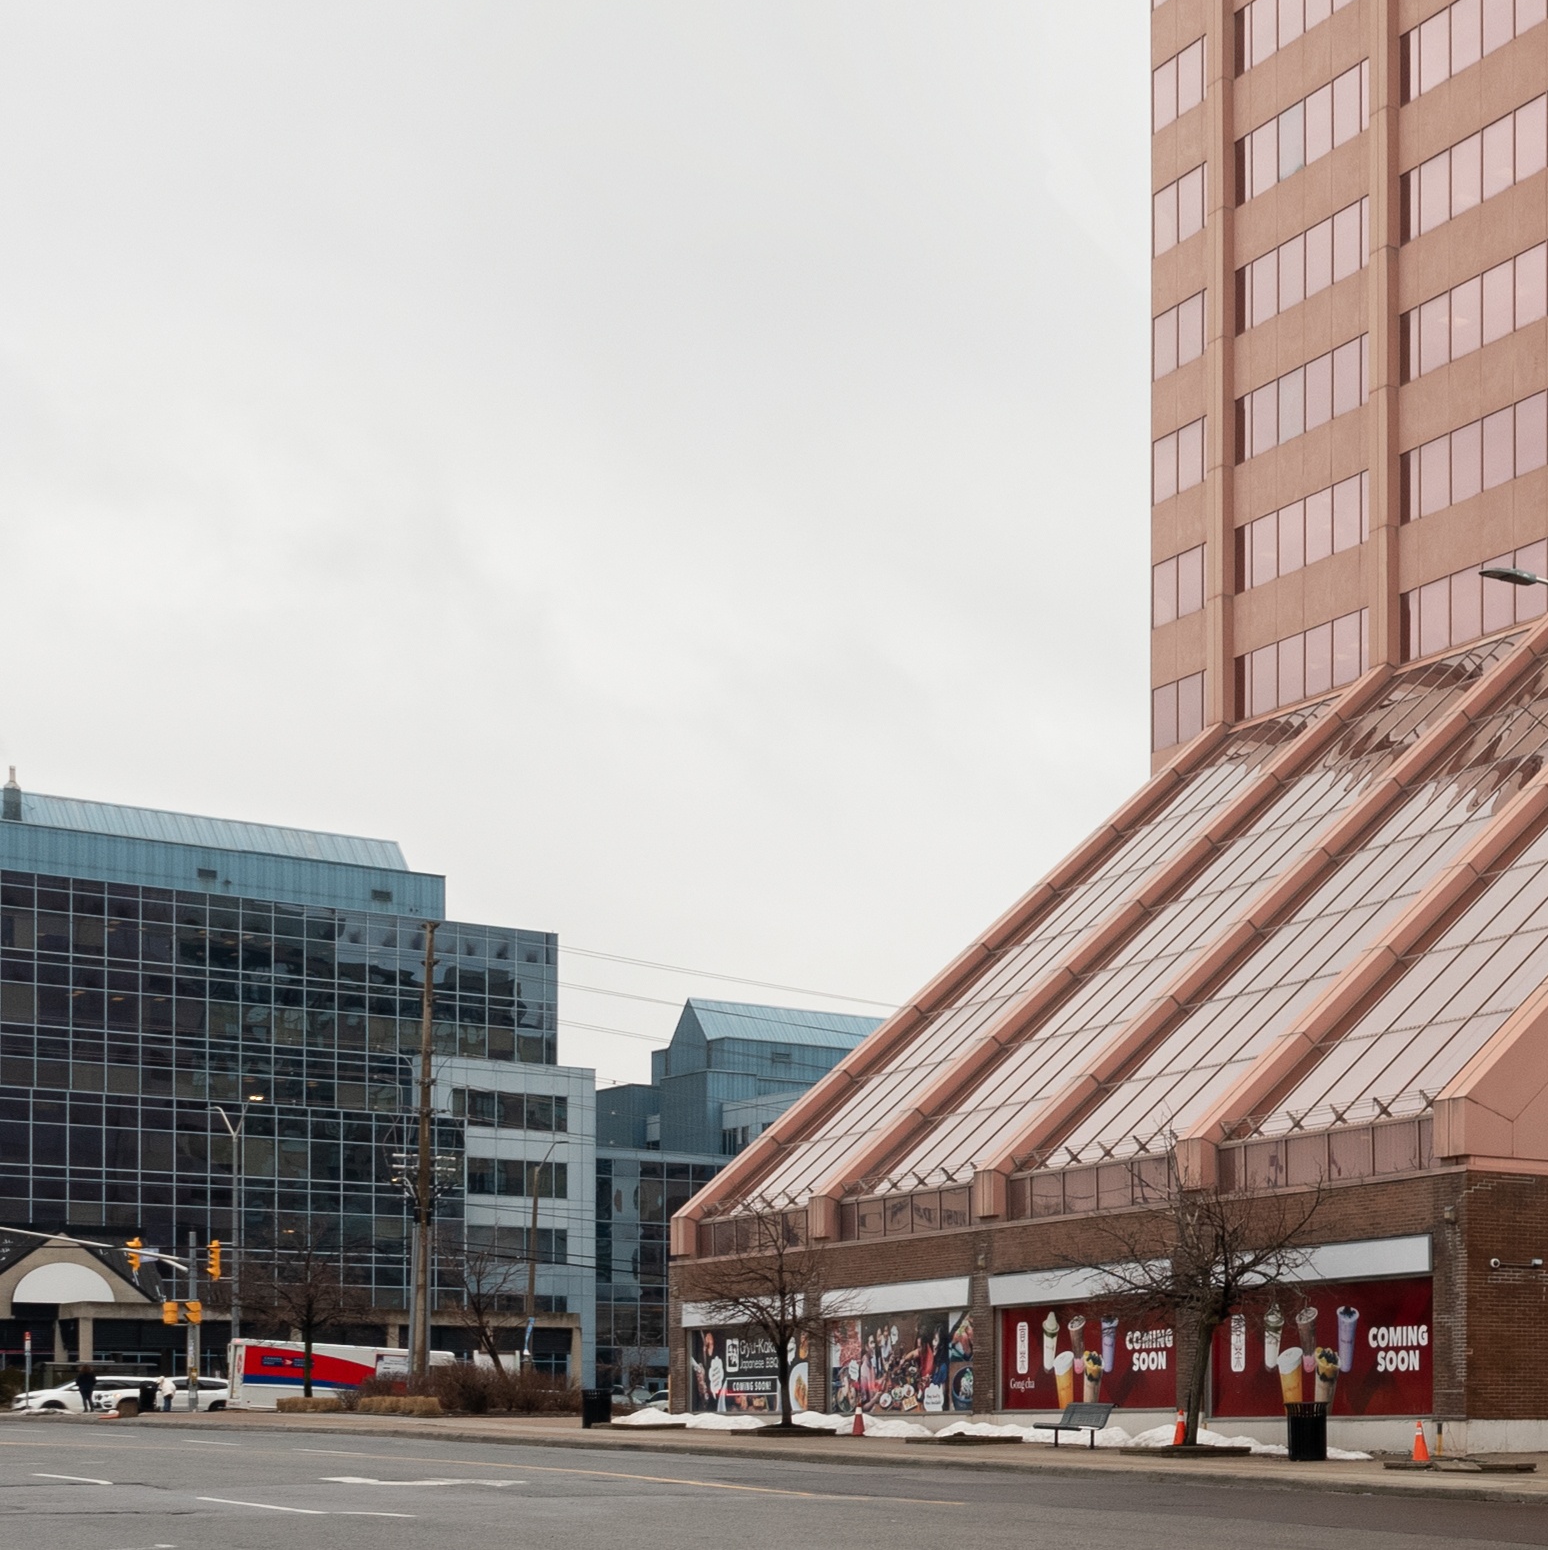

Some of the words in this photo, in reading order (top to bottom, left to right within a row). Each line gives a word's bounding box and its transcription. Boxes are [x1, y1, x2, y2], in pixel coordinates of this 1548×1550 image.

[1125, 1328, 1174, 1350] COMING
[1368, 1324, 1429, 1349] COMING
[740, 1358, 765, 1371] Japanese
[765, 1356, 779, 1368] BBQ
[1132, 1351, 1167, 1372] SOON
[1377, 1349, 1420, 1372] SOON
[732, 1381, 754, 1391] COMING
[754, 1380, 772, 1391] SOON!
